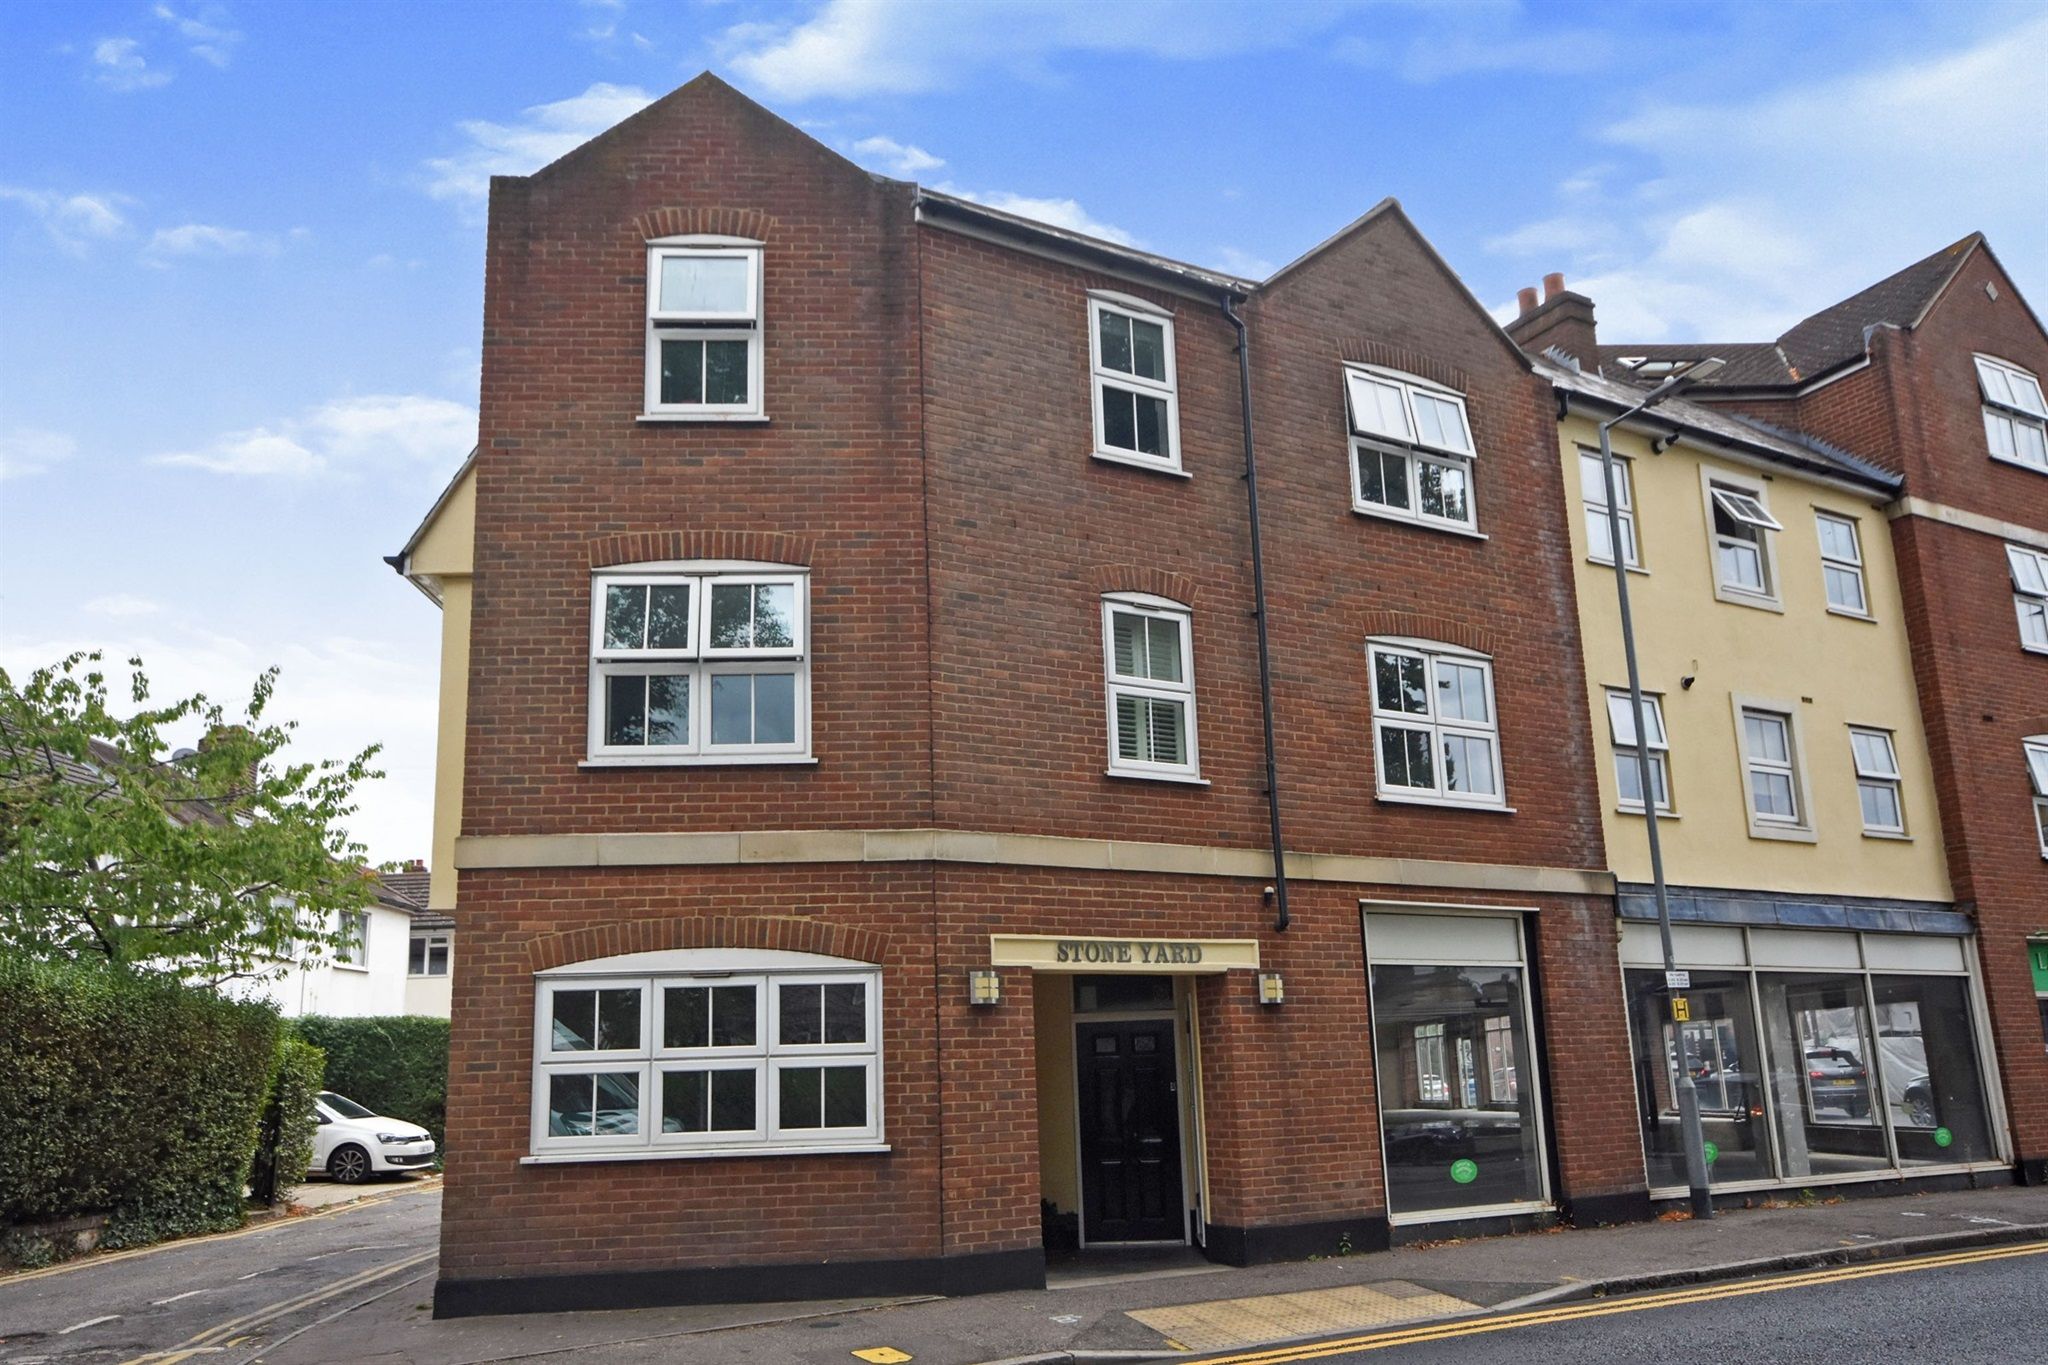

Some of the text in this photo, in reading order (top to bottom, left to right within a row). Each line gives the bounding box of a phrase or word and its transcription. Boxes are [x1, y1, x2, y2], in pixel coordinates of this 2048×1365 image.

[1056, 940, 1203, 964] STONE YARD
[1675, 1000, 1688, 1019] H
